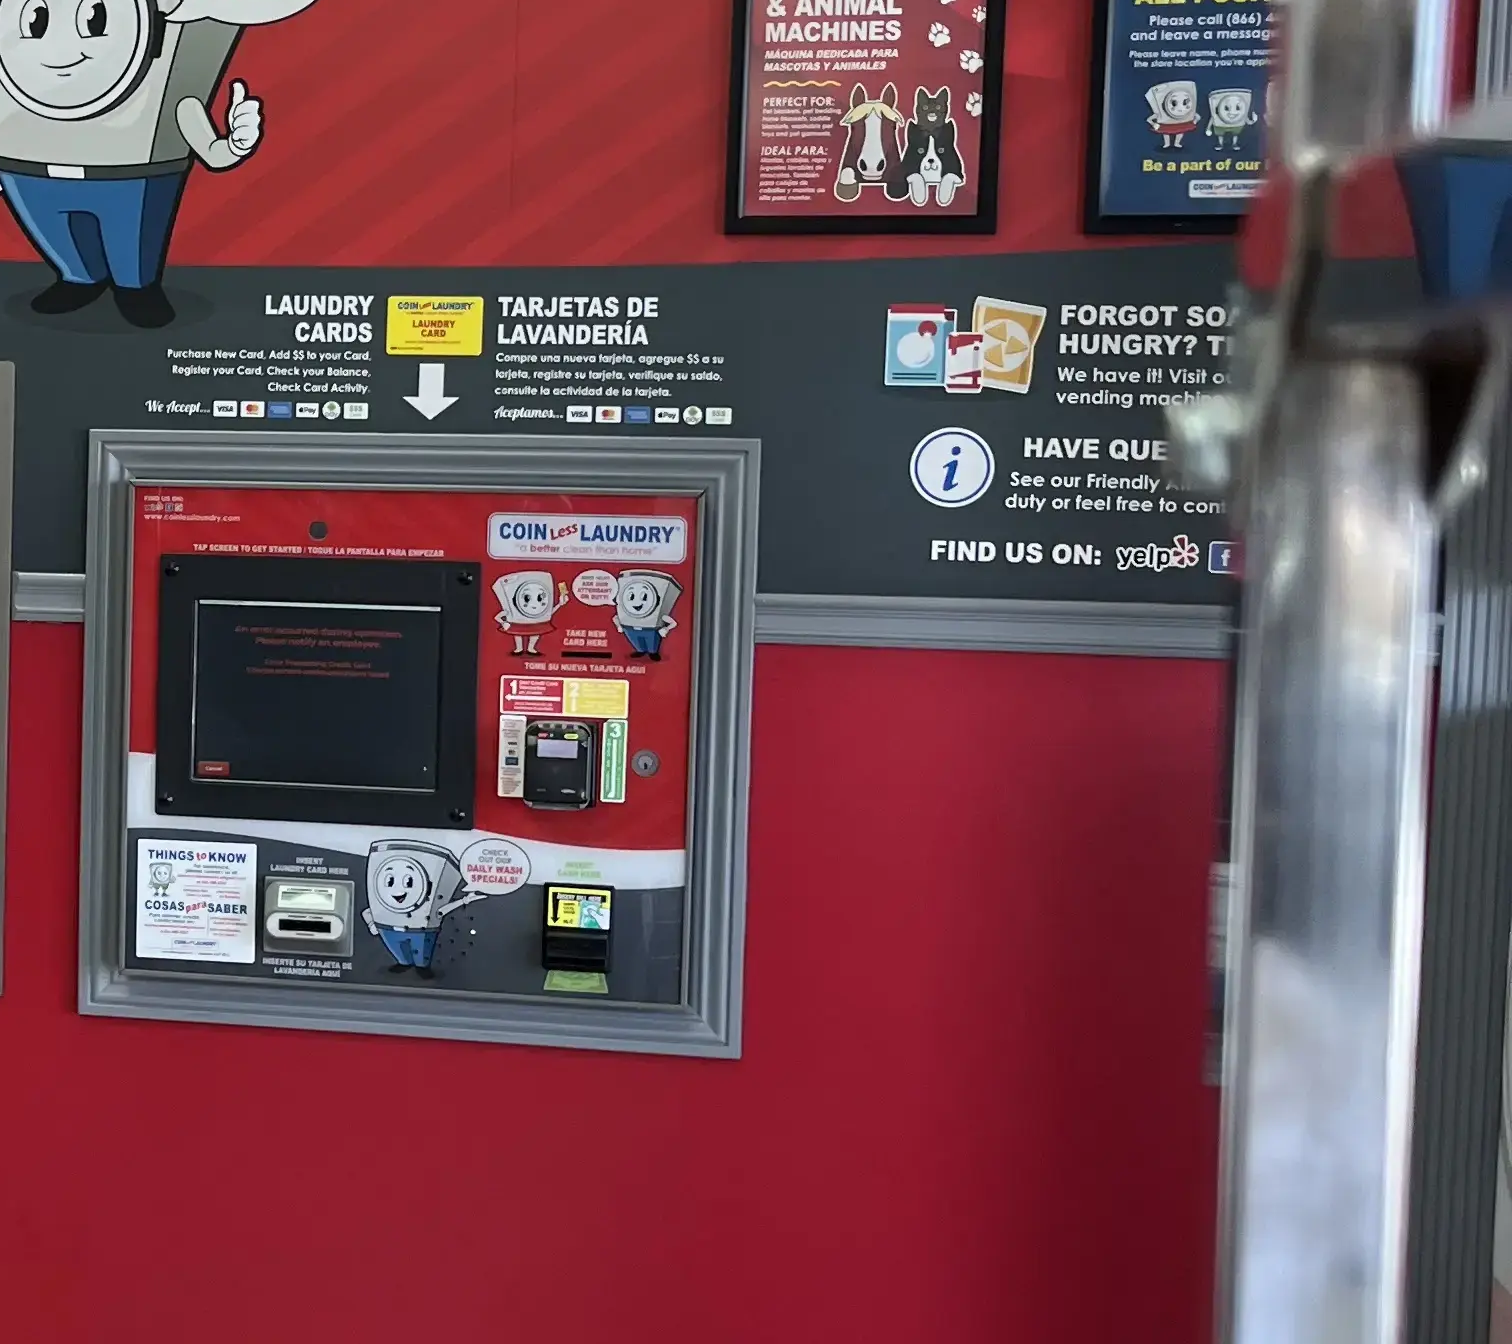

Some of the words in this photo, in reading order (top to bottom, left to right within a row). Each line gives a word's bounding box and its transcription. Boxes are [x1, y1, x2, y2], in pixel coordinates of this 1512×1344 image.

[1149, 15, 1193, 26] Please
[1197, 13, 1223, 25] call
[1226, 12, 1261, 27] (866)
[765, 20, 901, 42] MACHINES
[265, 295, 374, 315] LAUNDRY
[497, 296, 619, 317] TARJETAS
[627, 296, 658, 317] DE
[1060, 304, 1178, 326] FORGOT
[294, 322, 372, 343] CARDS
[497, 319, 648, 345] LAVANDERÍA
[1059, 333, 1197, 355] HUNGRY?
[1057, 366, 1087, 382] We
[1092, 367, 1140, 383] have
[1146, 367, 1162, 383] it!
[1168, 368, 1207, 384] Visit
[1055, 389, 1133, 408] vending
[1023, 437, 1099, 459] HAVE
[1009, 471, 1045, 487] See
[1050, 475, 1081, 488] our
[1086, 473, 1160, 493] Friendly
[1004, 493, 1046, 512] duty
[1051, 497, 1071, 509] or
[1075, 494, 1110, 510] feel
[1116, 496, 1153, 512] free
[1158, 497, 1177, 512] to
[499, 522, 547, 541] COIN
[550, 523, 578, 540] Less
[580, 524, 675, 544] LAUNDRY
[931, 540, 996, 562] FIND
[1005, 541, 1042, 563] US
[1052, 543, 1101, 565] ON:
[1116, 546, 1171, 572] yelp
[148, 849, 194, 861] THINGS
[196, 851, 207, 861] to
[208, 852, 247, 863] KNOW
